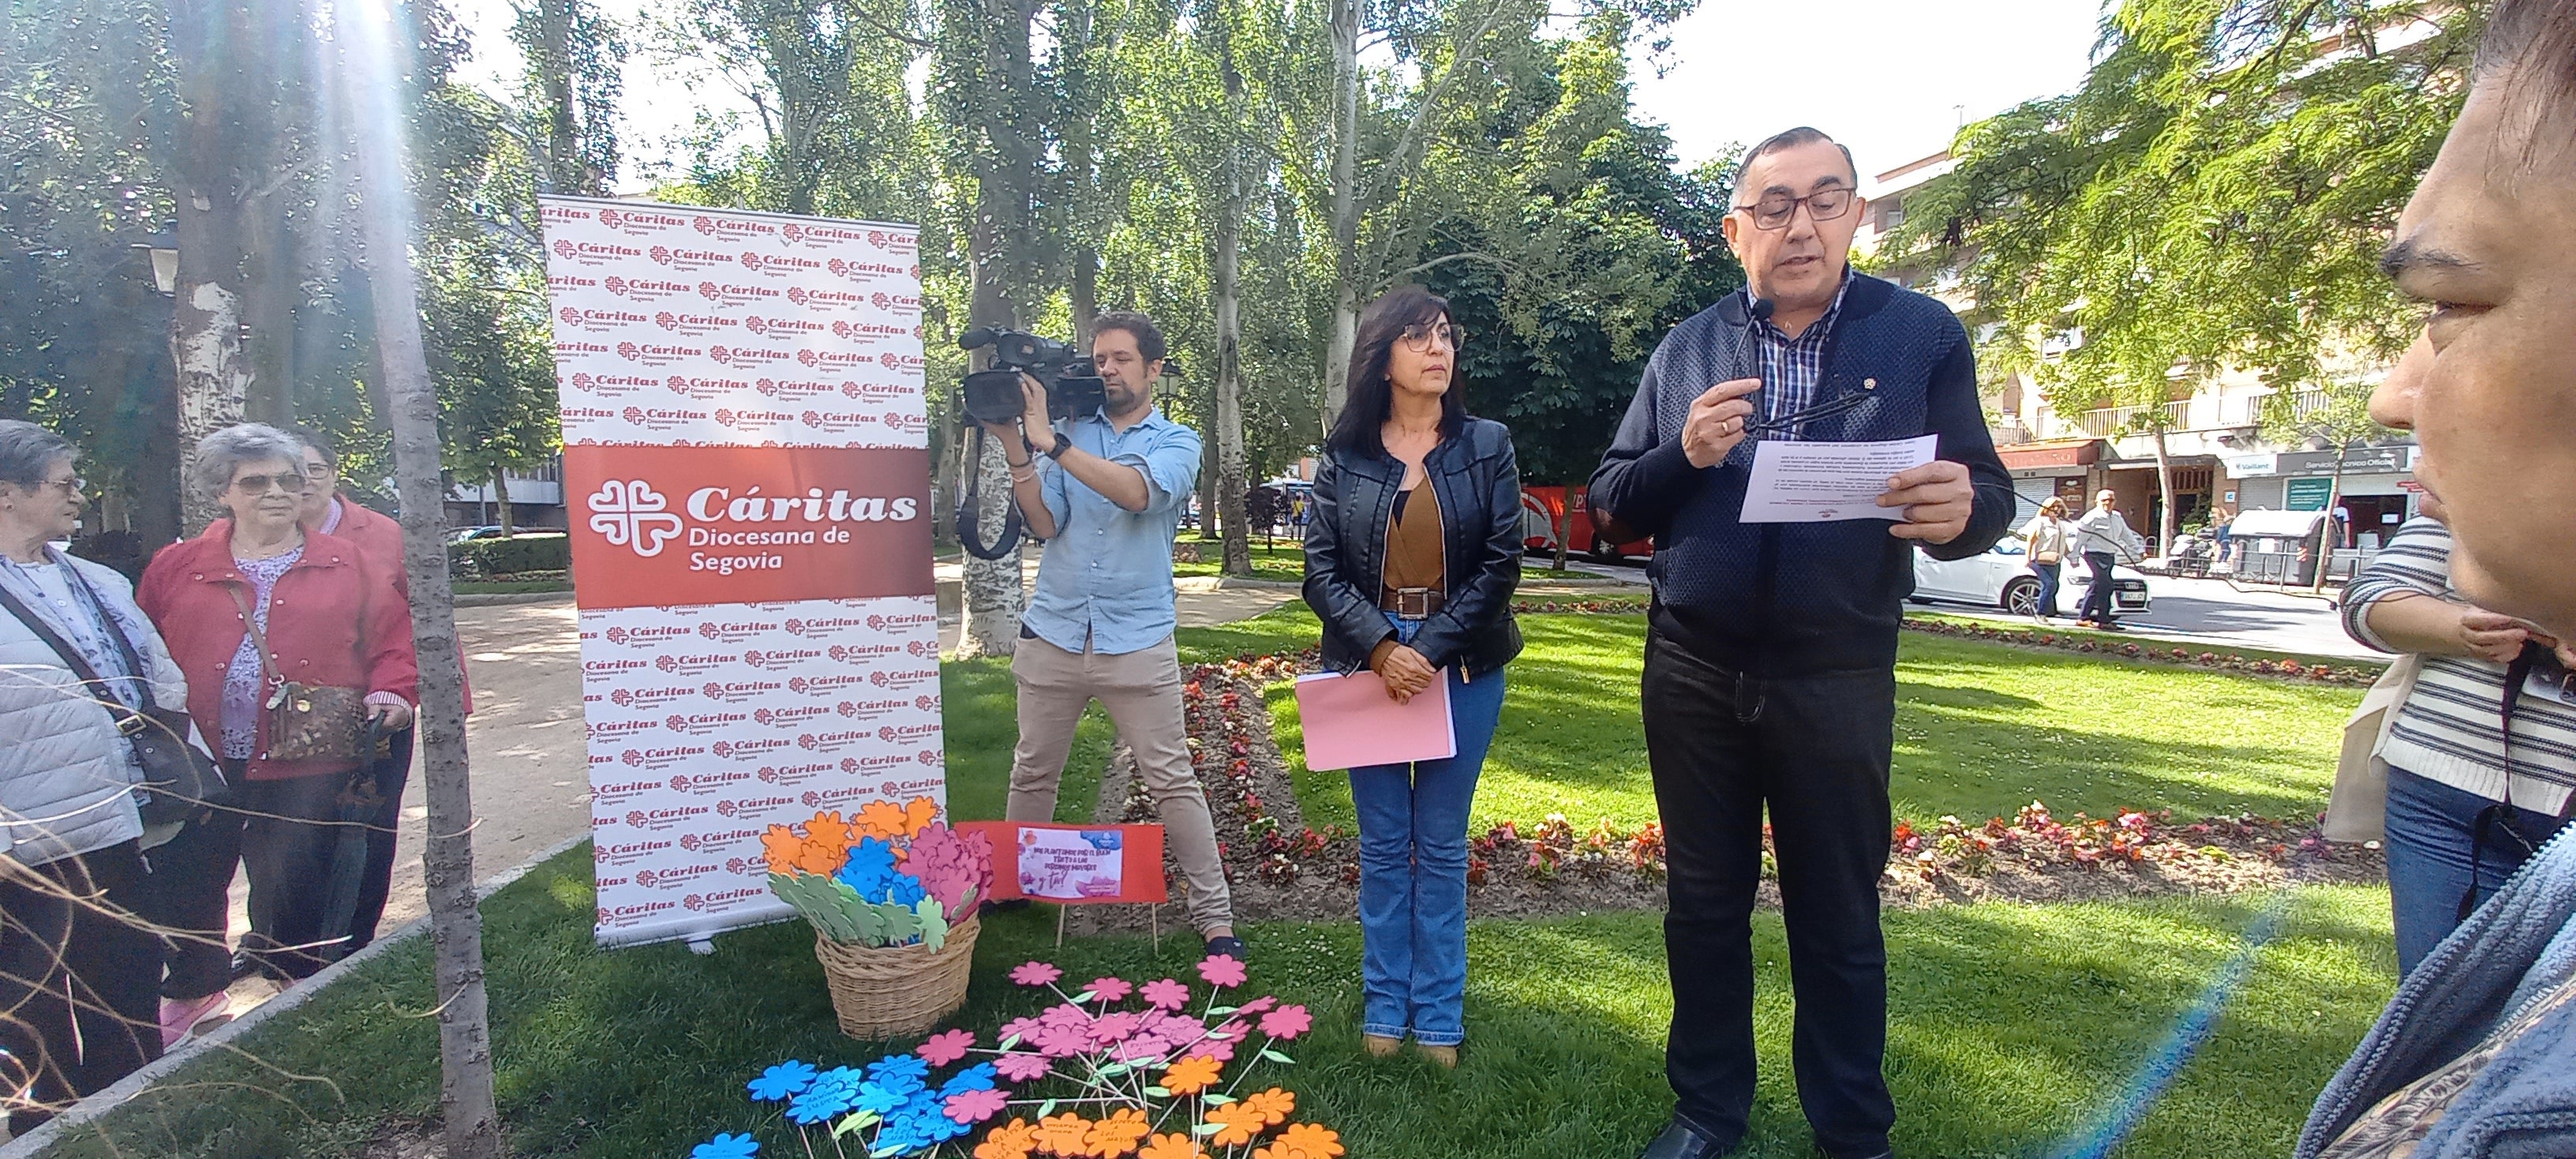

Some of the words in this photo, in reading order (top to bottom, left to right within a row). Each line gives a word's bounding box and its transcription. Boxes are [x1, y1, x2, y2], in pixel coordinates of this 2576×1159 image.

[623, 213, 685, 226] Cáritas
[717, 220, 775, 233] Cáritas
[805, 227, 860, 239] Cáritas
[578, 242, 641, 256] Cáritas
[673, 249, 732, 261] Cáritas
[763, 255, 820, 268] Cáritas
[849, 261, 902, 274] Cáritas
[629, 279, 690, 291] Cáritas
[722, 284, 779, 297] Cáritas
[809, 290, 864, 302] Cáritas
[584, 309, 646, 322] Cáritas
[679, 314, 737, 326] Cáritas
[768, 318, 824, 330] Cáritas
[853, 323, 906, 335] Cáritas
[642, 344, 701, 355] Cáritas
[732, 347, 789, 359] Cáritas
[819, 351, 873, 362] Cáritas
[597, 376, 658, 386] Cáritas
[691, 378, 748, 388] Cáritas
[779, 381, 833, 391] Cáritas
[863, 383, 914, 394] Cáritas
[647, 409, 706, 419] Cáritas
[737, 411, 794, 421] Cáritas
[823, 412, 877, 422] Cáritas
[686, 486, 918, 523] Cáritas
[689, 527, 814, 547] Diocesana
[822, 525, 850, 544] de
[689, 551, 783, 576] Segovia
[806, 617, 859, 628] Cáritas
[887, 614, 936, 624] Cáritas
[631, 626, 691, 636] Cáritas
[721, 623, 777, 632] Cáritas
[766, 649, 821, 660] Cáritas
[848, 644, 900, 655] Cáritas
[586, 661, 646, 670] Cáritas
[680, 655, 736, 665] Cáritas
[811, 676, 863, 686] Cáritas
[889, 670, 938, 681] Cáritas
[635, 687, 695, 698] Cáritas
[725, 681, 781, 692] Cáritas
[857, 700, 908, 711] Cáritas
[776, 707, 829, 718] Cáritas
[689, 714, 746, 725] Cáritas
[597, 720, 657, 732] Cáritas
[898, 723, 942, 734] Cárita
[819, 731, 871, 742] Cáritas
[735, 738, 790, 750] Cáritas
[645, 745, 705, 758] Cáritas
[860, 756, 912, 767] Cáritas
[779, 764, 833, 776] Cáritas
[693, 772, 750, 784] Cáritas
[601, 782, 661, 794] Cáritas
[901, 780, 944, 791] Cárita
[822, 787, 874, 799] Cáritas
[739, 796, 794, 808] Cáritas
[650, 805, 708, 818] Cáritas
[702, 829, 759, 842] Cáritas
[611, 841, 671, 853] Cáritas
[660, 865, 718, 878] Cáritas
[706, 887, 763, 902] Cáritas
[615, 900, 675, 915] Cáritas
